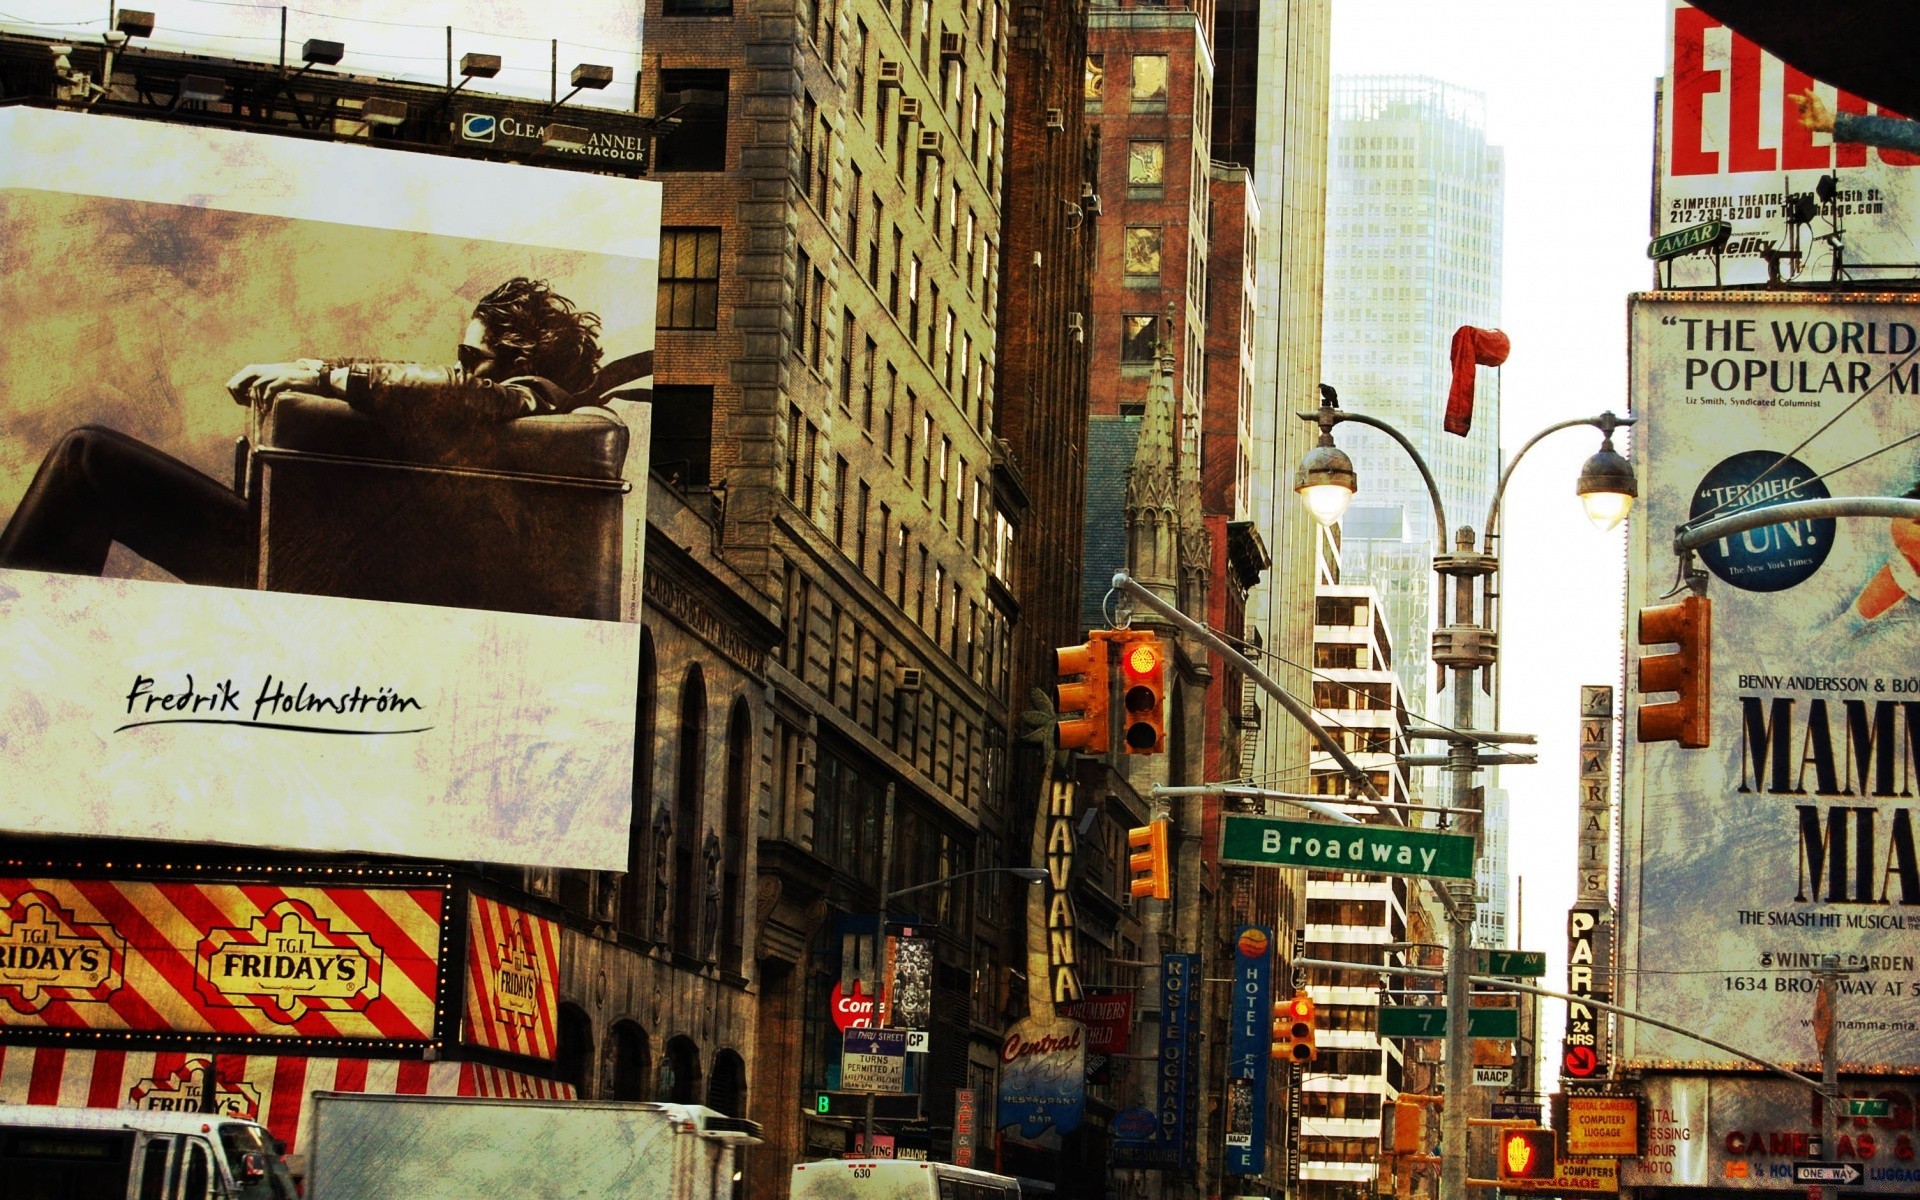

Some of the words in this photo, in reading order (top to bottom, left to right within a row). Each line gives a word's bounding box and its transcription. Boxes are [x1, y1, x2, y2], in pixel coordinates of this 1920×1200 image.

[500, 118, 545, 139] CLEA
[588, 133, 645, 151] ANNEL
[1684, 197, 1735, 210] IMPERIAL
[1739, 193, 1783, 206] THEATRE
[1867, 188, 1884, 201] St.
[1670, 208, 1761, 224] 212-239-6200
[1766, 209, 1777, 218] or
[1651, 225, 1713, 256] LAMAR
[1770, 320, 1917, 354] WORLD
[1685, 358, 1872, 394] POPULAR
[1686, 397, 1697, 405] Liz
[1700, 397, 1727, 406] Smith,
[1730, 397, 1776, 408] Syndicated
[1778, 398, 1821, 408] Columnist
[1729, 566, 1745, 575] The
[1747, 564, 1764, 573] New
[1767, 561, 1785, 570] York
[1788, 557, 1813, 566] Times
[1738, 675, 1784, 690] BENNY
[1786, 676, 1868, 692] ANDERSSON
[1874, 679, 1885, 692] &
[126, 674, 240, 714] Fredrik
[252, 674, 427, 721] Holmström
[1586, 726, 1607, 890] MARAIS
[1261, 829, 1437, 872] Broadway
[1048, 781, 1083, 1003] HAVANA
[1737, 910, 1765, 926] THE
[1767, 911, 1816, 927] SMASH
[1819, 913, 1843, 928] HIT
[1846, 914, 1906, 930] MUSICAL
[20, 928, 51, 944] T.G.I.
[276, 938, 307, 954] T.G.I.
[223, 953, 356, 982] FRIDAY'S
[1497, 953, 1512, 973] 7
[1523, 954, 1539, 965] AV
[1570, 912, 1595, 1020] PARK
[501, 970, 534, 1000] FRIDAY'S
[1724, 977, 1768, 991] 1634
[1775, 977, 1877, 995] BROAWAY
[1883, 981, 1904, 996] AT
[1166, 961, 1183, 1040] ROSIE
[1245, 967, 1259, 1037] HOTEL
[1418, 1013, 1433, 1032] 7
[1573, 1021, 1590, 1033] 24
[878, 1032, 905, 1042] STREET
[1086, 1026, 1113, 1045] ORLD
[1566, 1033, 1594, 1046] HRS
[1002, 1026, 1081, 1065] Central
[860, 1054, 889, 1064] TURNS
[847, 1063, 888, 1074] PERMITTED
[890, 1066, 900, 1075] AT
[1476, 1070, 1509, 1082] NAACP
[148, 1097, 241, 1115] FRIDY'S
[1004, 1096, 1078, 1106] RESTAURANT
[1291, 1087, 1299, 1118] MIRIAM
[1570, 1100, 1597, 1111] DIGITAL
[1600, 1101, 1636, 1112] CAMERAS
[1856, 1101, 1866, 1114] 7
[1028, 1115, 1052, 1124] BAR
[1579, 1114, 1626, 1125] COMPUTERS
[1228, 1134, 1249, 1145] NAACP
[1584, 1127, 1621, 1138] LUGGAGE
[1725, 1130, 1877, 1158] CAMEAS
[853, 1168, 871, 1179] 630
[1289, 1149, 1298, 1180] HAROLD
[1562, 1165, 1614, 1178] COMPUTERS
[1637, 1161, 1673, 1174] PHOTO
[1803, 1169, 1823, 1179] ONE
[1832, 1169, 1854, 1179] WAY
